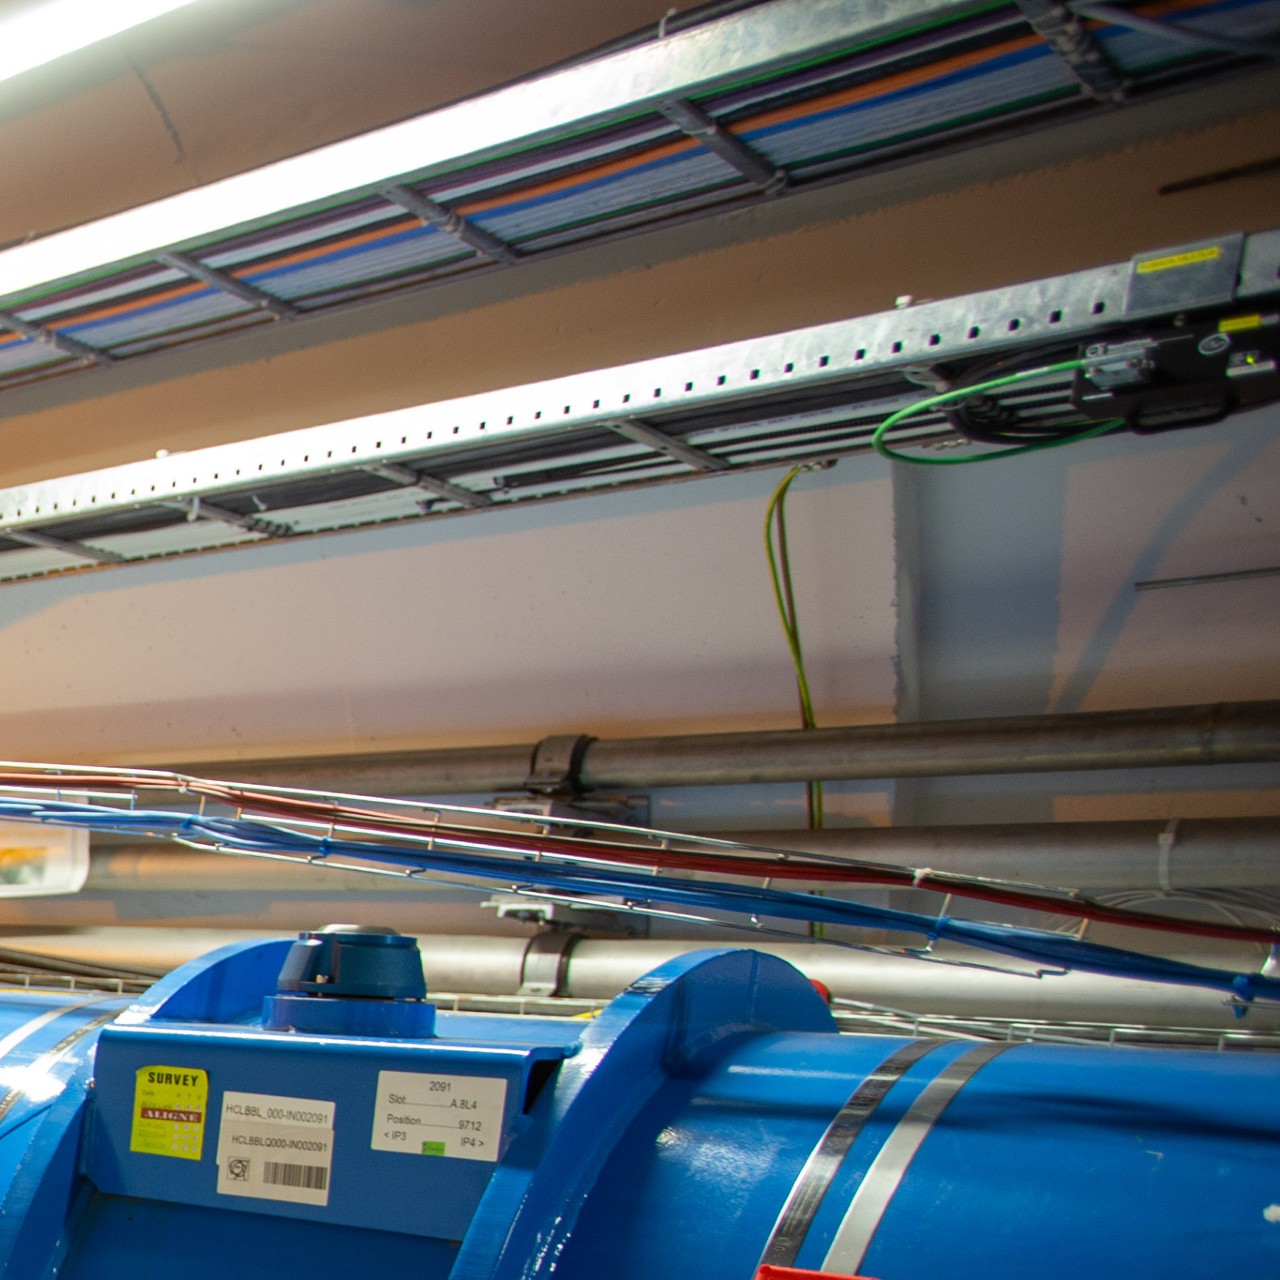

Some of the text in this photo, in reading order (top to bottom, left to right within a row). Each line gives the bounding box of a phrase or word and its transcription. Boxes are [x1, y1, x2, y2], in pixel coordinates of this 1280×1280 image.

[147, 1071, 199, 1087] SURVEY
[429, 1081, 451, 1092] 2091
[386, 1113, 482, 1132] Position 9712
[391, 1131, 407, 1141] IP3
[460, 1137, 476, 1147] IP4
